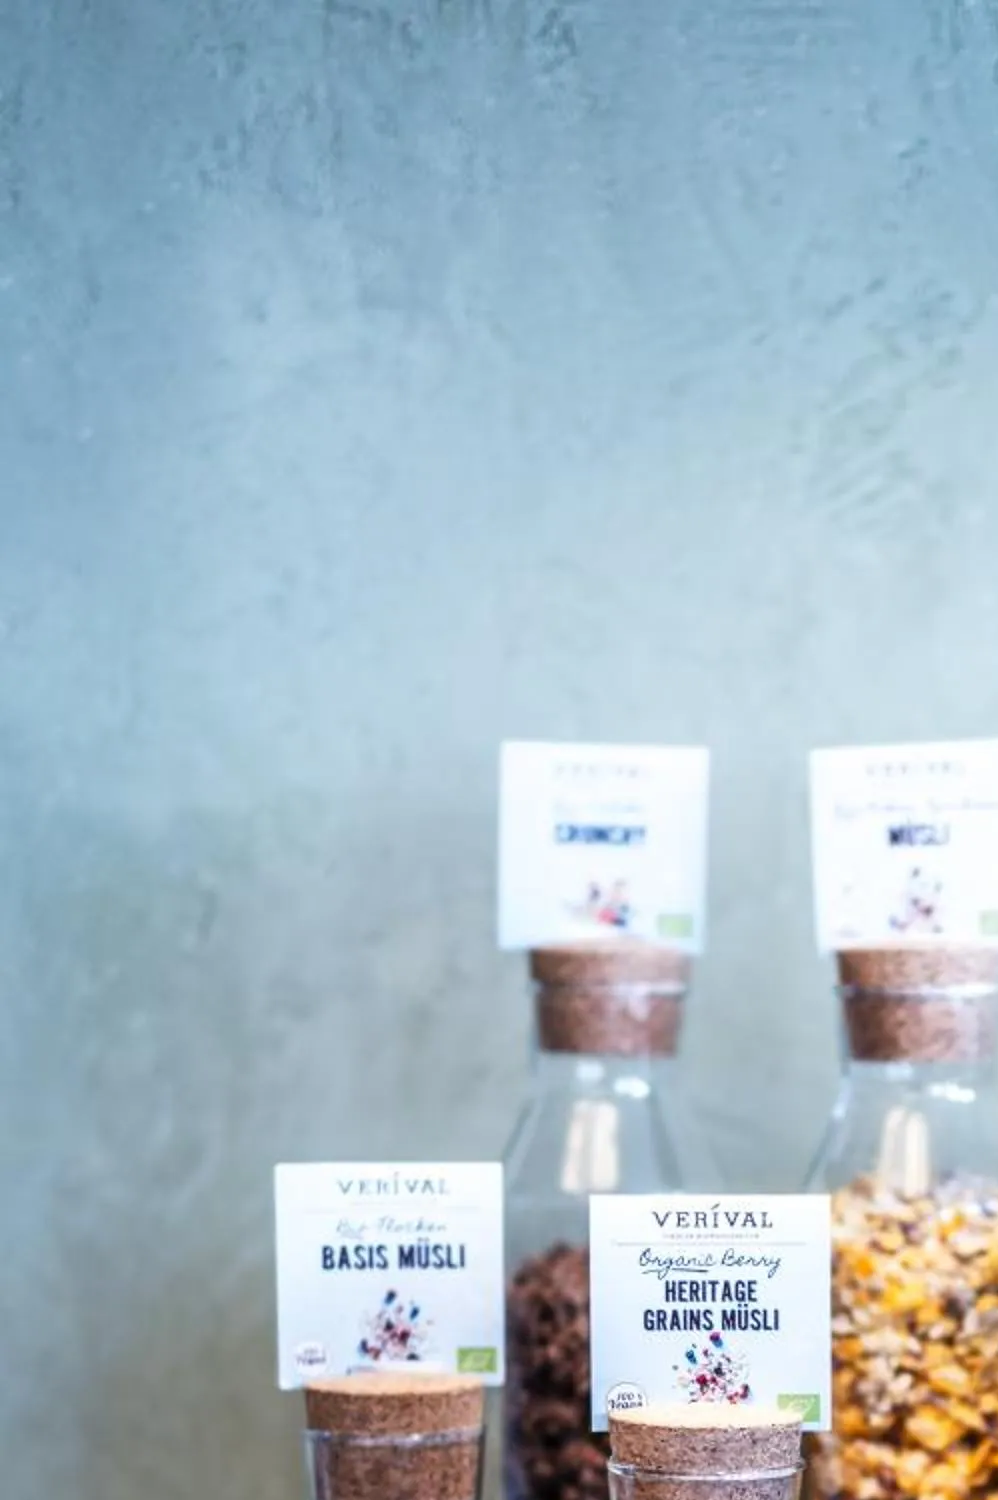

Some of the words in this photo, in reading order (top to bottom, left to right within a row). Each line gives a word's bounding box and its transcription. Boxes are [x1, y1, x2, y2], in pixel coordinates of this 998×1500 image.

[321, 1245, 389, 1270] BASIS
[398, 1237, 466, 1270] MÜSLI
[639, 1248, 716, 1281] Organic
[721, 1248, 782, 1279] Berry
[664, 1279, 758, 1303] HERITAGE
[643, 1308, 715, 1332] GRAINS
[721, 1303, 780, 1331] MÜSLI
